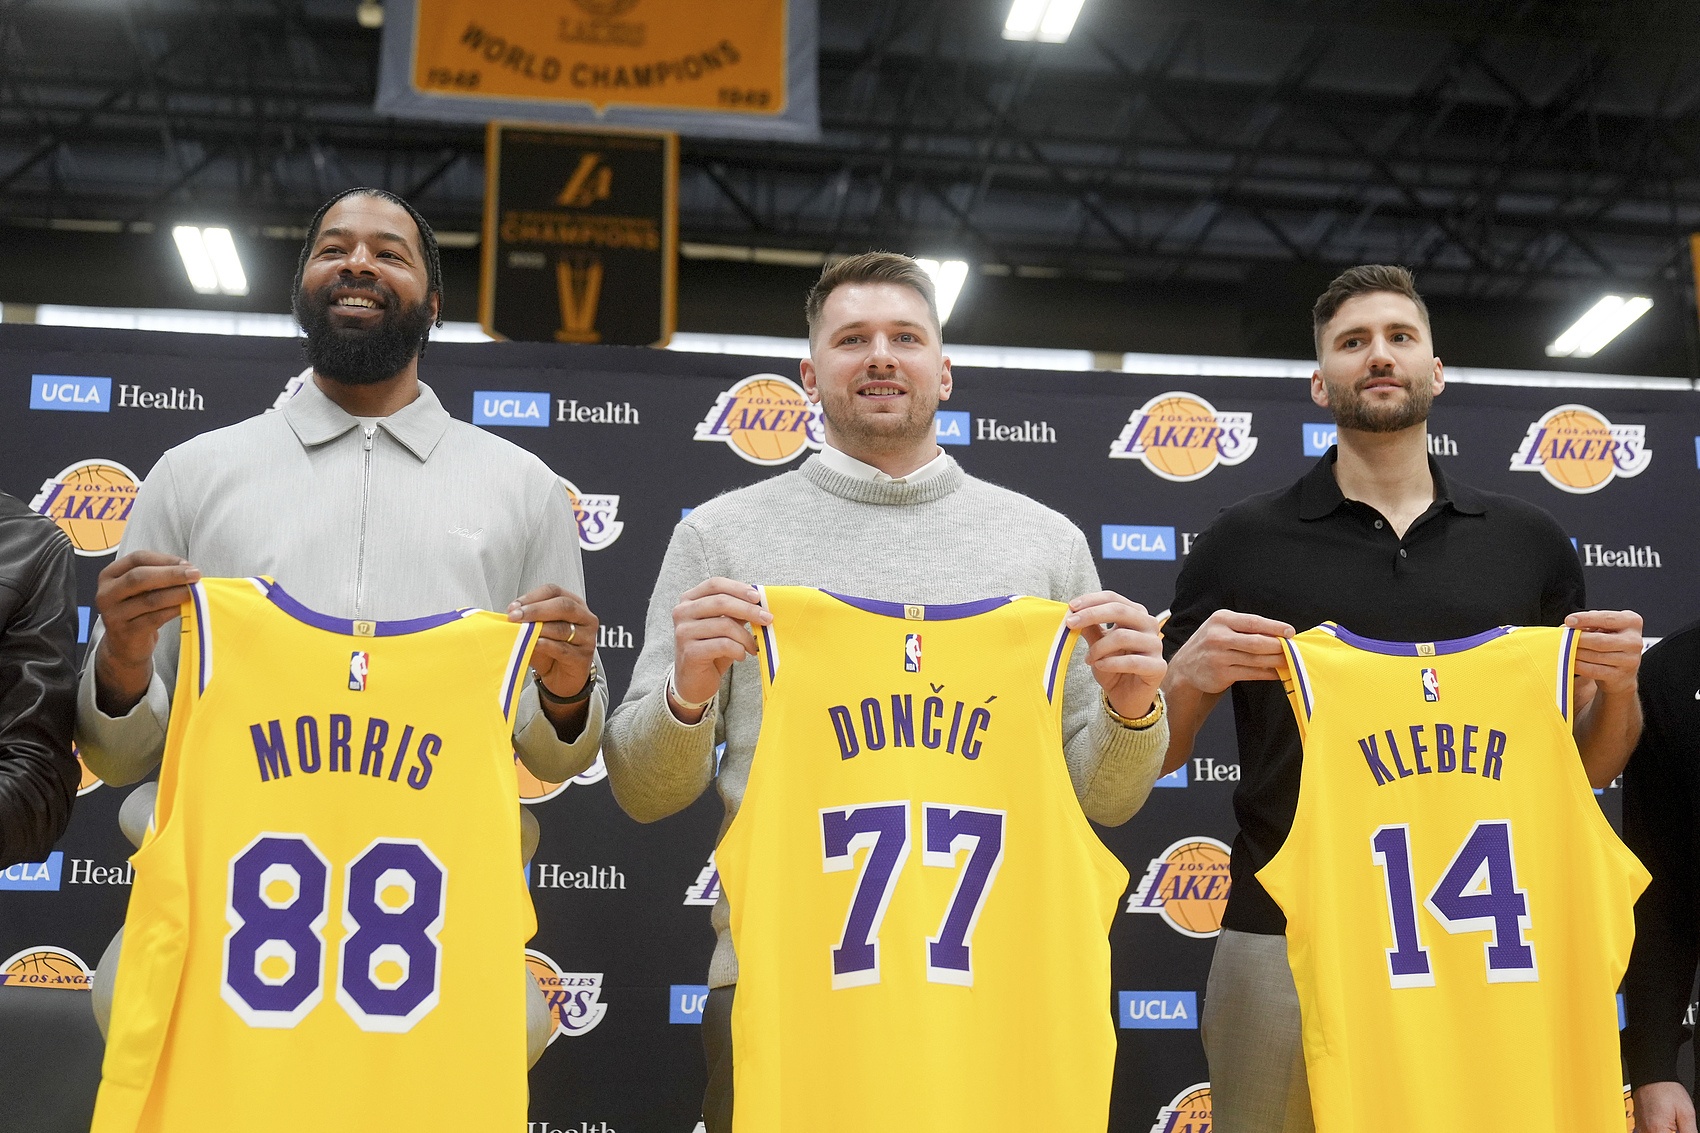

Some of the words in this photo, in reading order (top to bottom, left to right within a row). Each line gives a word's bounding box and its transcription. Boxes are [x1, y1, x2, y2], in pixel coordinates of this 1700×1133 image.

[461, 22, 562, 83] WORLD
[569, 38, 741, 89] CHAMPIONS
[41, 383, 100, 404] UCLA
[117, 384, 205, 411] Health
[748, 397, 771, 405] LOS
[484, 399, 540, 418] UCLA
[556, 399, 639, 425] Health
[936, 418, 961, 437] LA
[976, 418, 1057, 443] Health
[1121, 414, 1250, 459] LAKERS
[1312, 431, 1338, 449] UC
[1427, 433, 1459, 456] lth
[1521, 427, 1646, 471] LAKERS
[75, 484, 101, 492] LOS
[1112, 532, 1167, 553] UCLA
[1582, 543, 1662, 568] Health
[597, 624, 634, 649] lth
[828, 682, 998, 761] DONČIĆ
[249, 713, 443, 791] MORRIS
[1357, 723, 1507, 787] KLEBER
[1193, 757, 1241, 782] Hea
[0, 862, 51, 881] CLA
[68, 858, 133, 885] Heal
[537, 863, 627, 890] Health
[1179, 863, 1205, 871] LOS
[818, 800, 1008, 991] 77
[1134, 862, 1231, 908] LAKE
[1369, 818, 1540, 990] 14
[219, 831, 449, 1034] 88
[19, 974, 48, 983] LOS
[49, 975, 94, 984] ANGE
[537, 977, 597, 987] NGELES
[1129, 1000, 1188, 1020] UCLA
